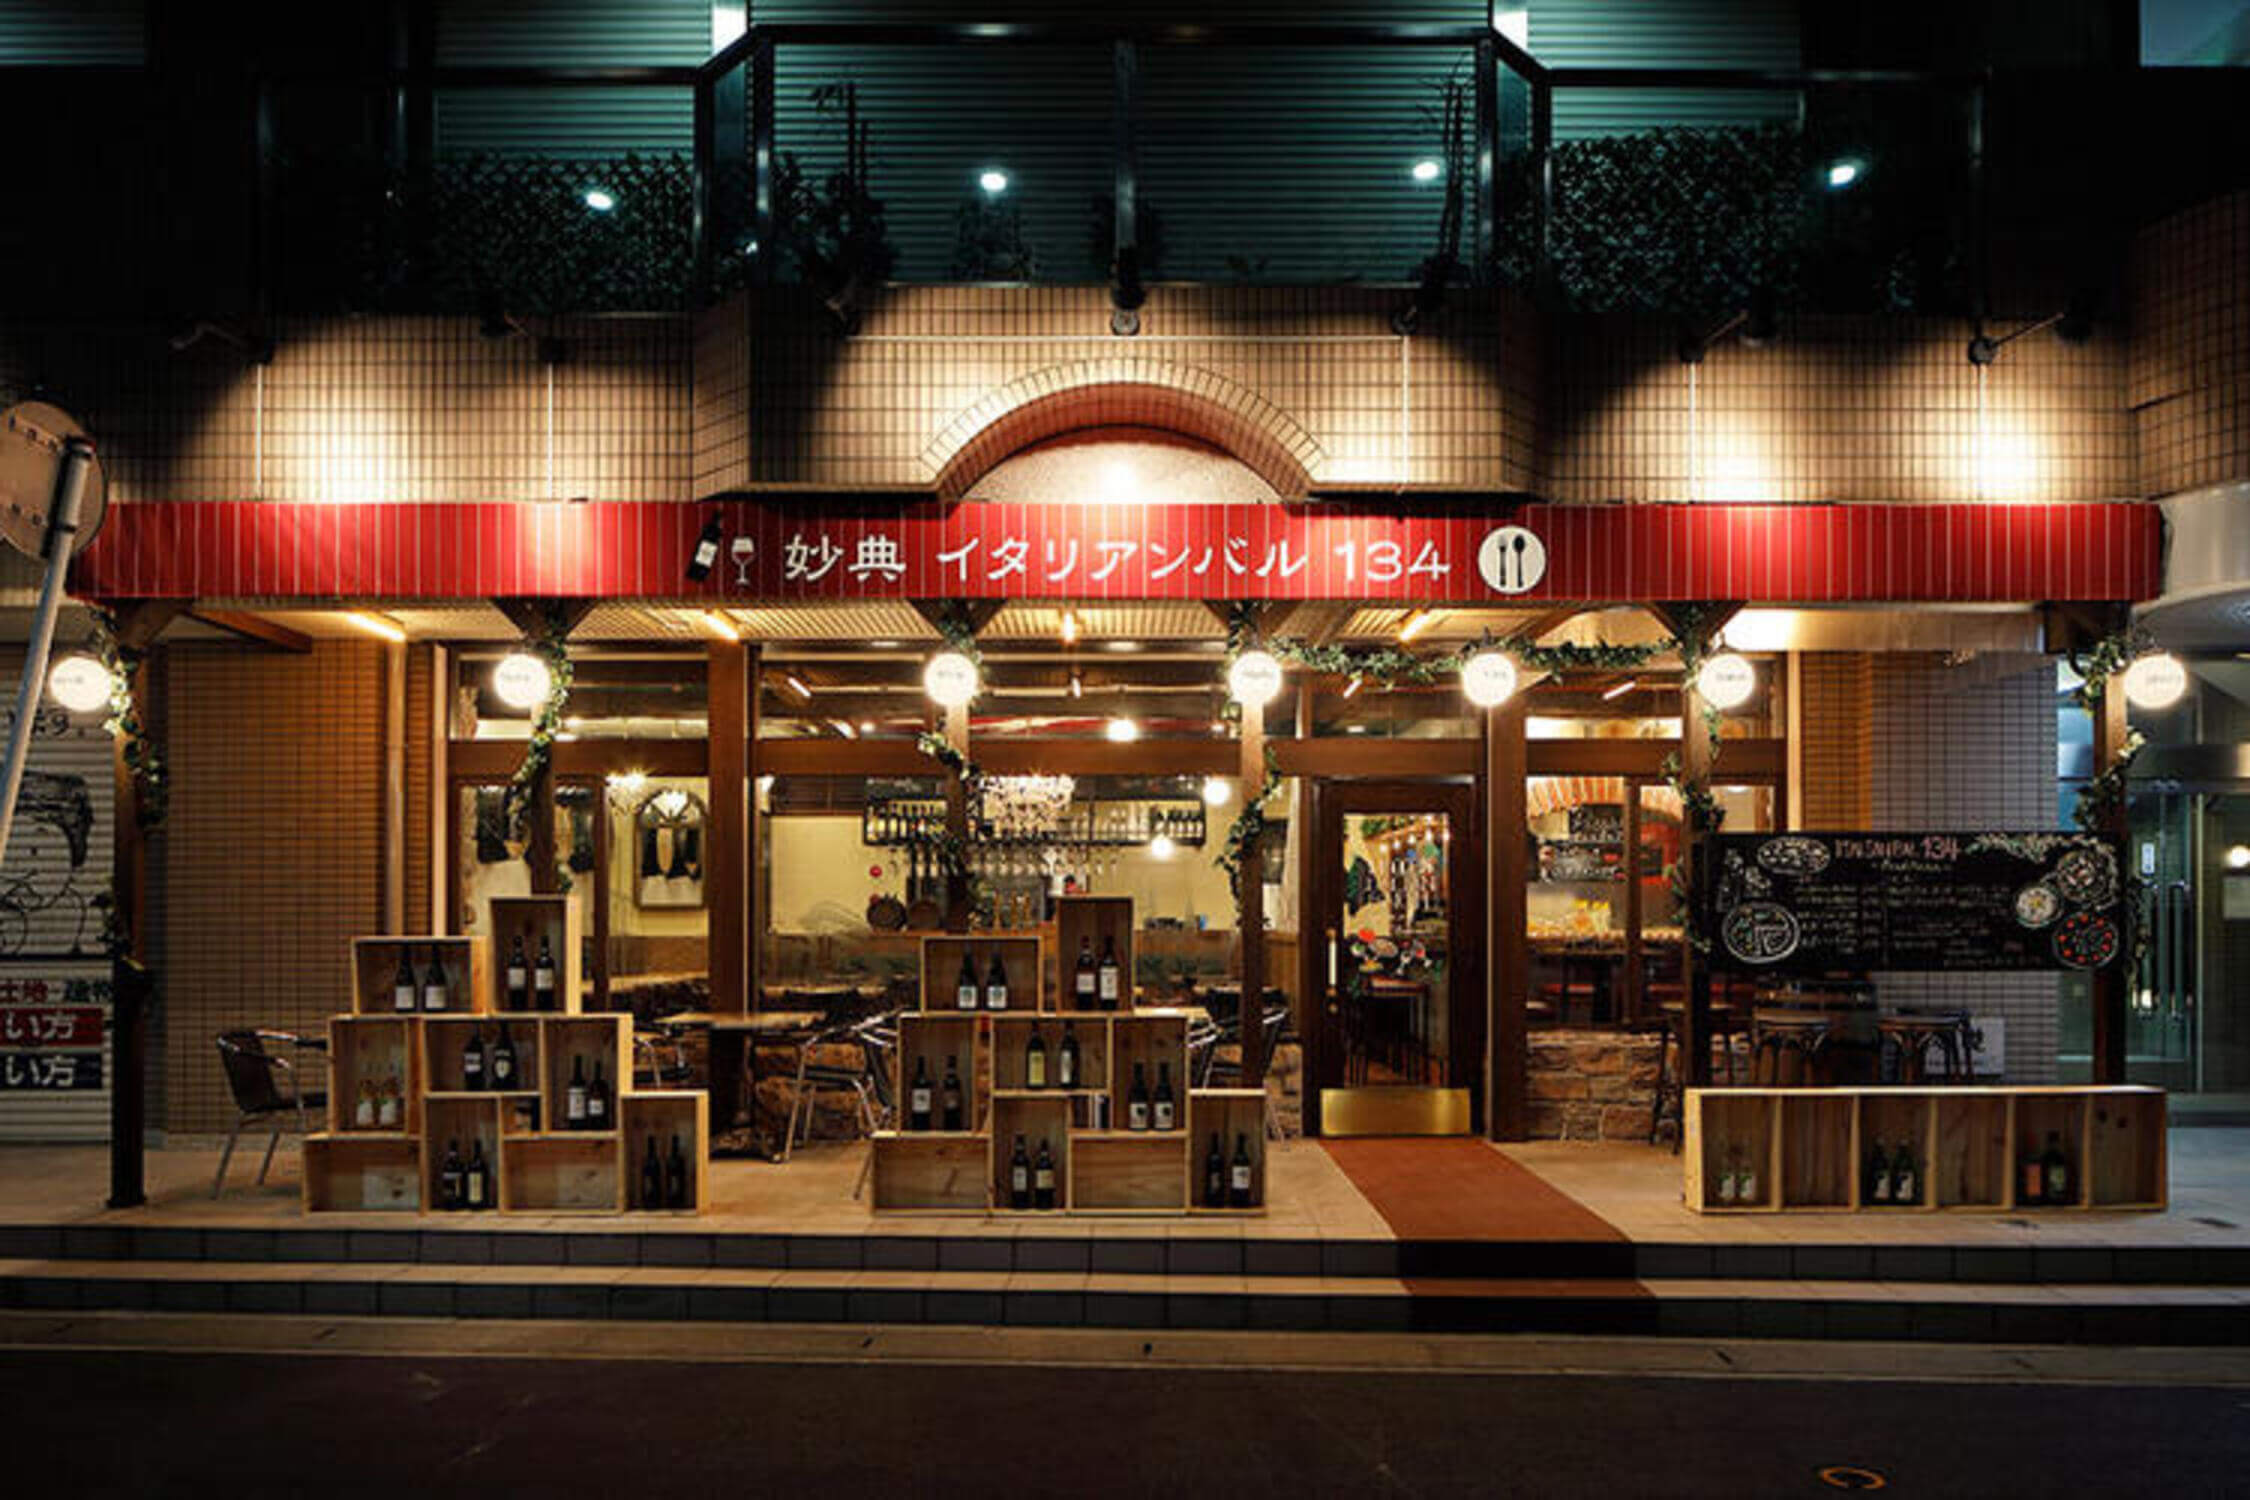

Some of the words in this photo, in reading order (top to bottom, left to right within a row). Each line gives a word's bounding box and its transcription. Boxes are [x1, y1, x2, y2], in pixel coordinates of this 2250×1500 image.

[784, 533, 906, 582] 妙典
[936, 536, 1308, 582] イタリアンバル
[1335, 539, 1450, 582] 134
[1922, 836, 1961, 861] 134
